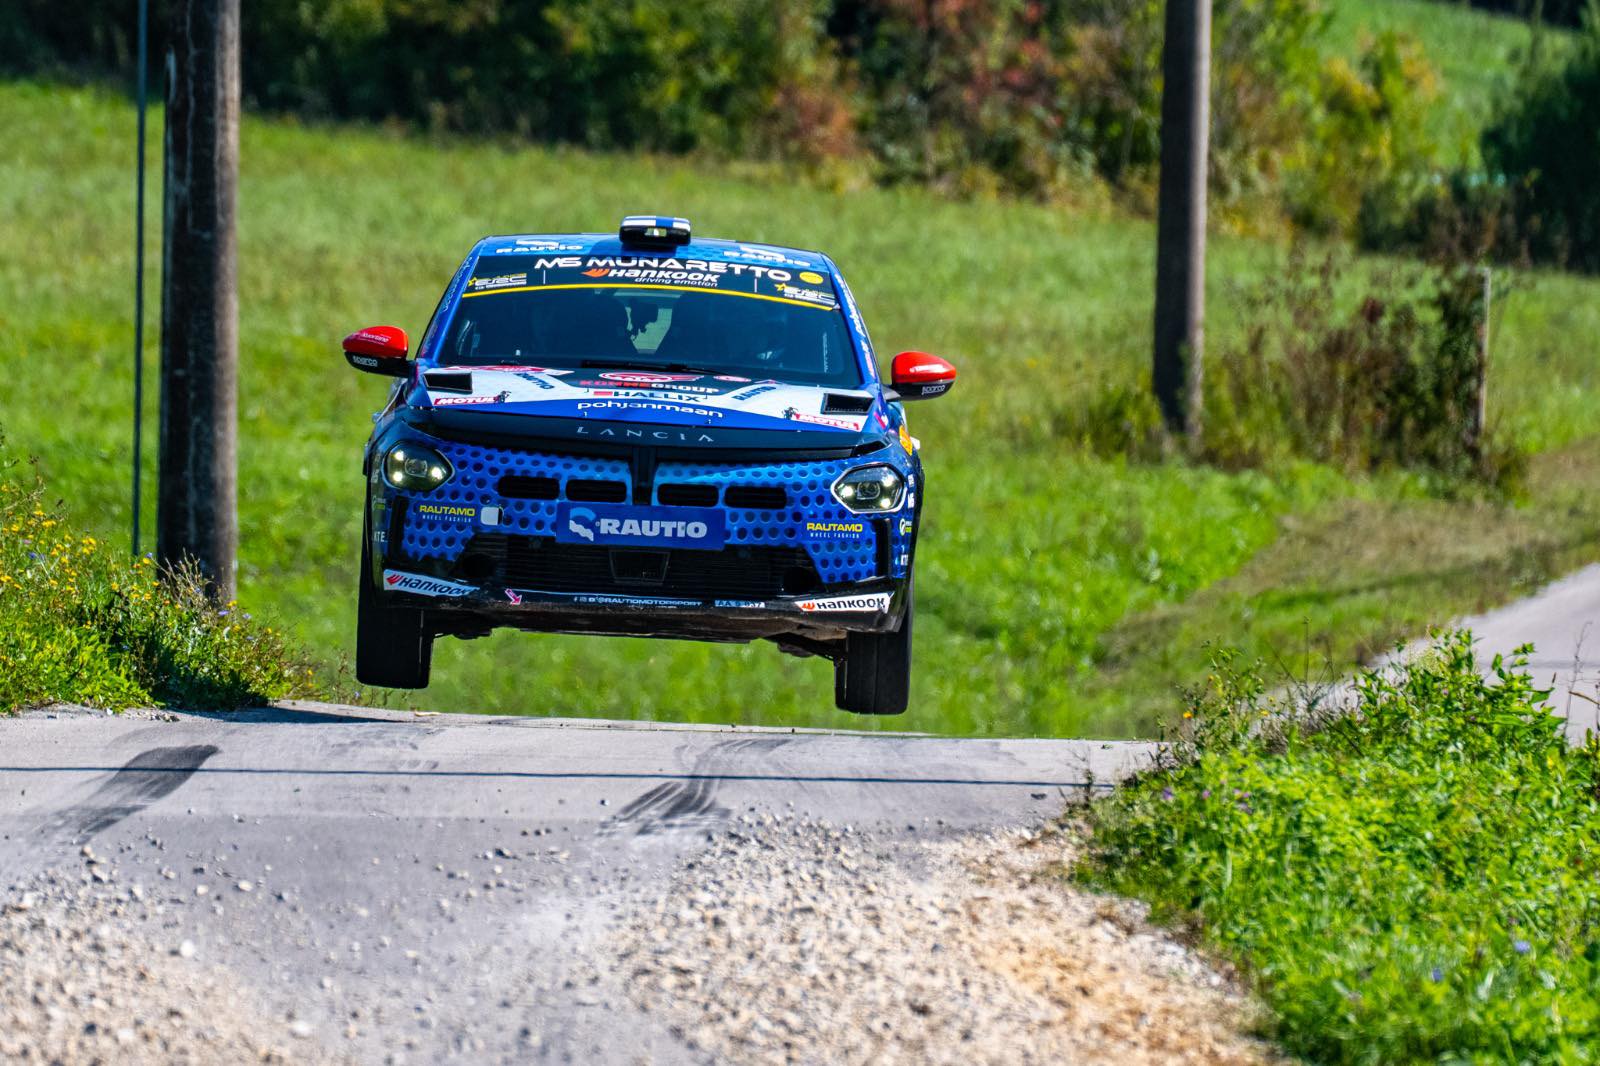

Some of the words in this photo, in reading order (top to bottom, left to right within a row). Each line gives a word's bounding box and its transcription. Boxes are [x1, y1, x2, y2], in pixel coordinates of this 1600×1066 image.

[534, 257, 581, 269] MS
[586, 257, 792, 282] MUNARETTO
[634, 277, 672, 285] driving
[673, 279, 718, 287] emotion
[613, 391, 700, 402] HALLIX
[577, 401, 723, 418] pohjanmaan
[576, 426, 714, 442] LANCIA
[419, 505, 476, 517] RAUTAMO
[599, 518, 708, 539] RAUTIO
[806, 523, 863, 532] RAUTAMO
